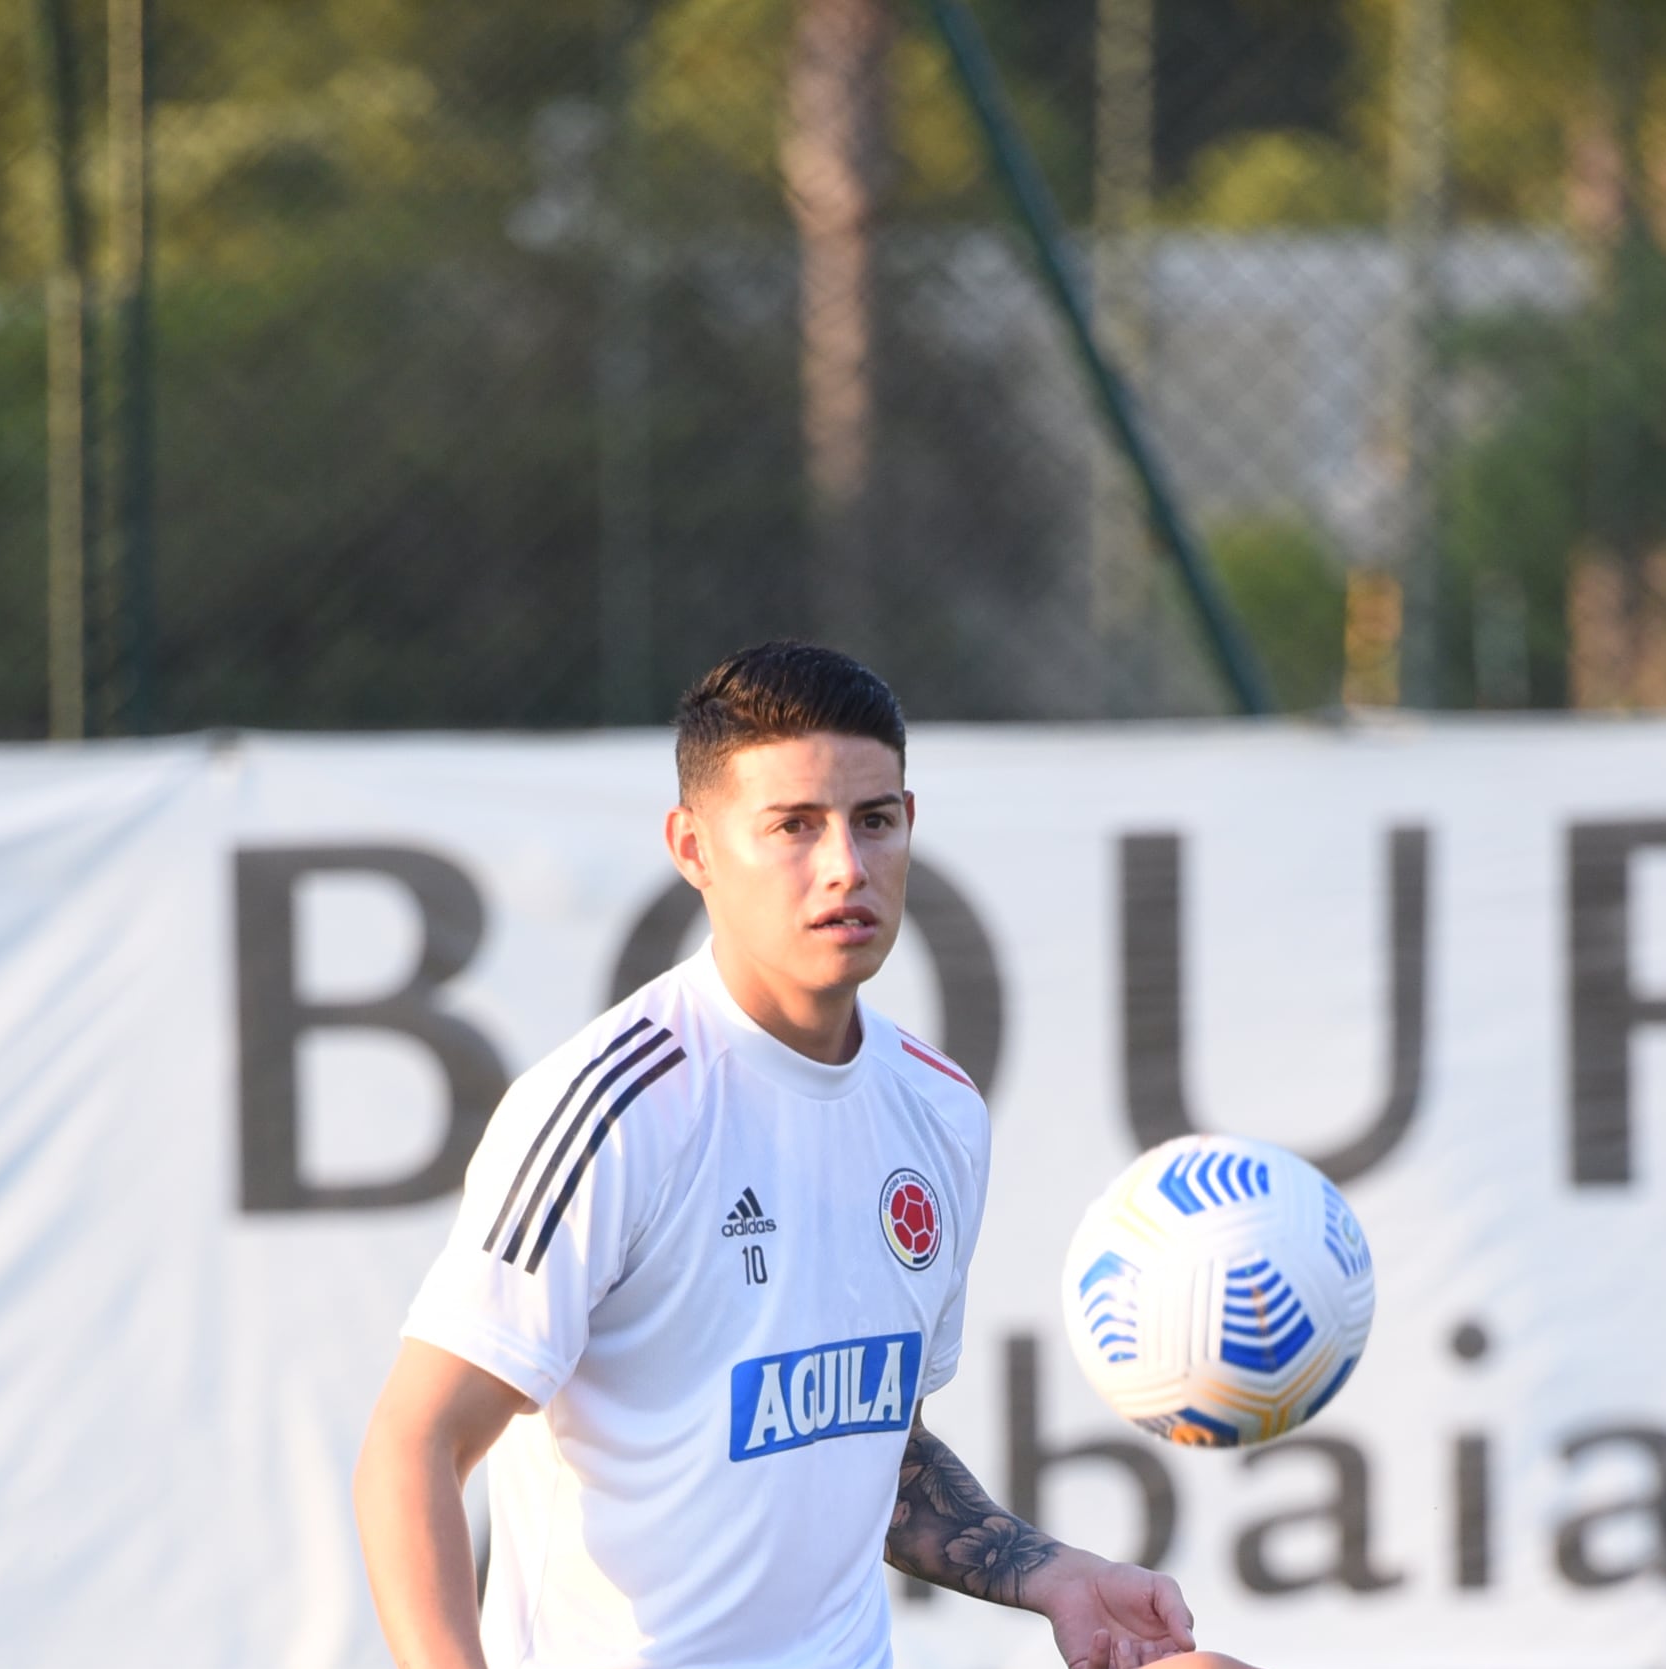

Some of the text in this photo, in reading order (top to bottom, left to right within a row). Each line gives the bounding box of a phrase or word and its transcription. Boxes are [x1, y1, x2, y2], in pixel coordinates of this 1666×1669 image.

[721, 1218, 777, 1237] adidas
[742, 1245, 768, 1286] 10
[744, 1341, 904, 1451] AGUILA
